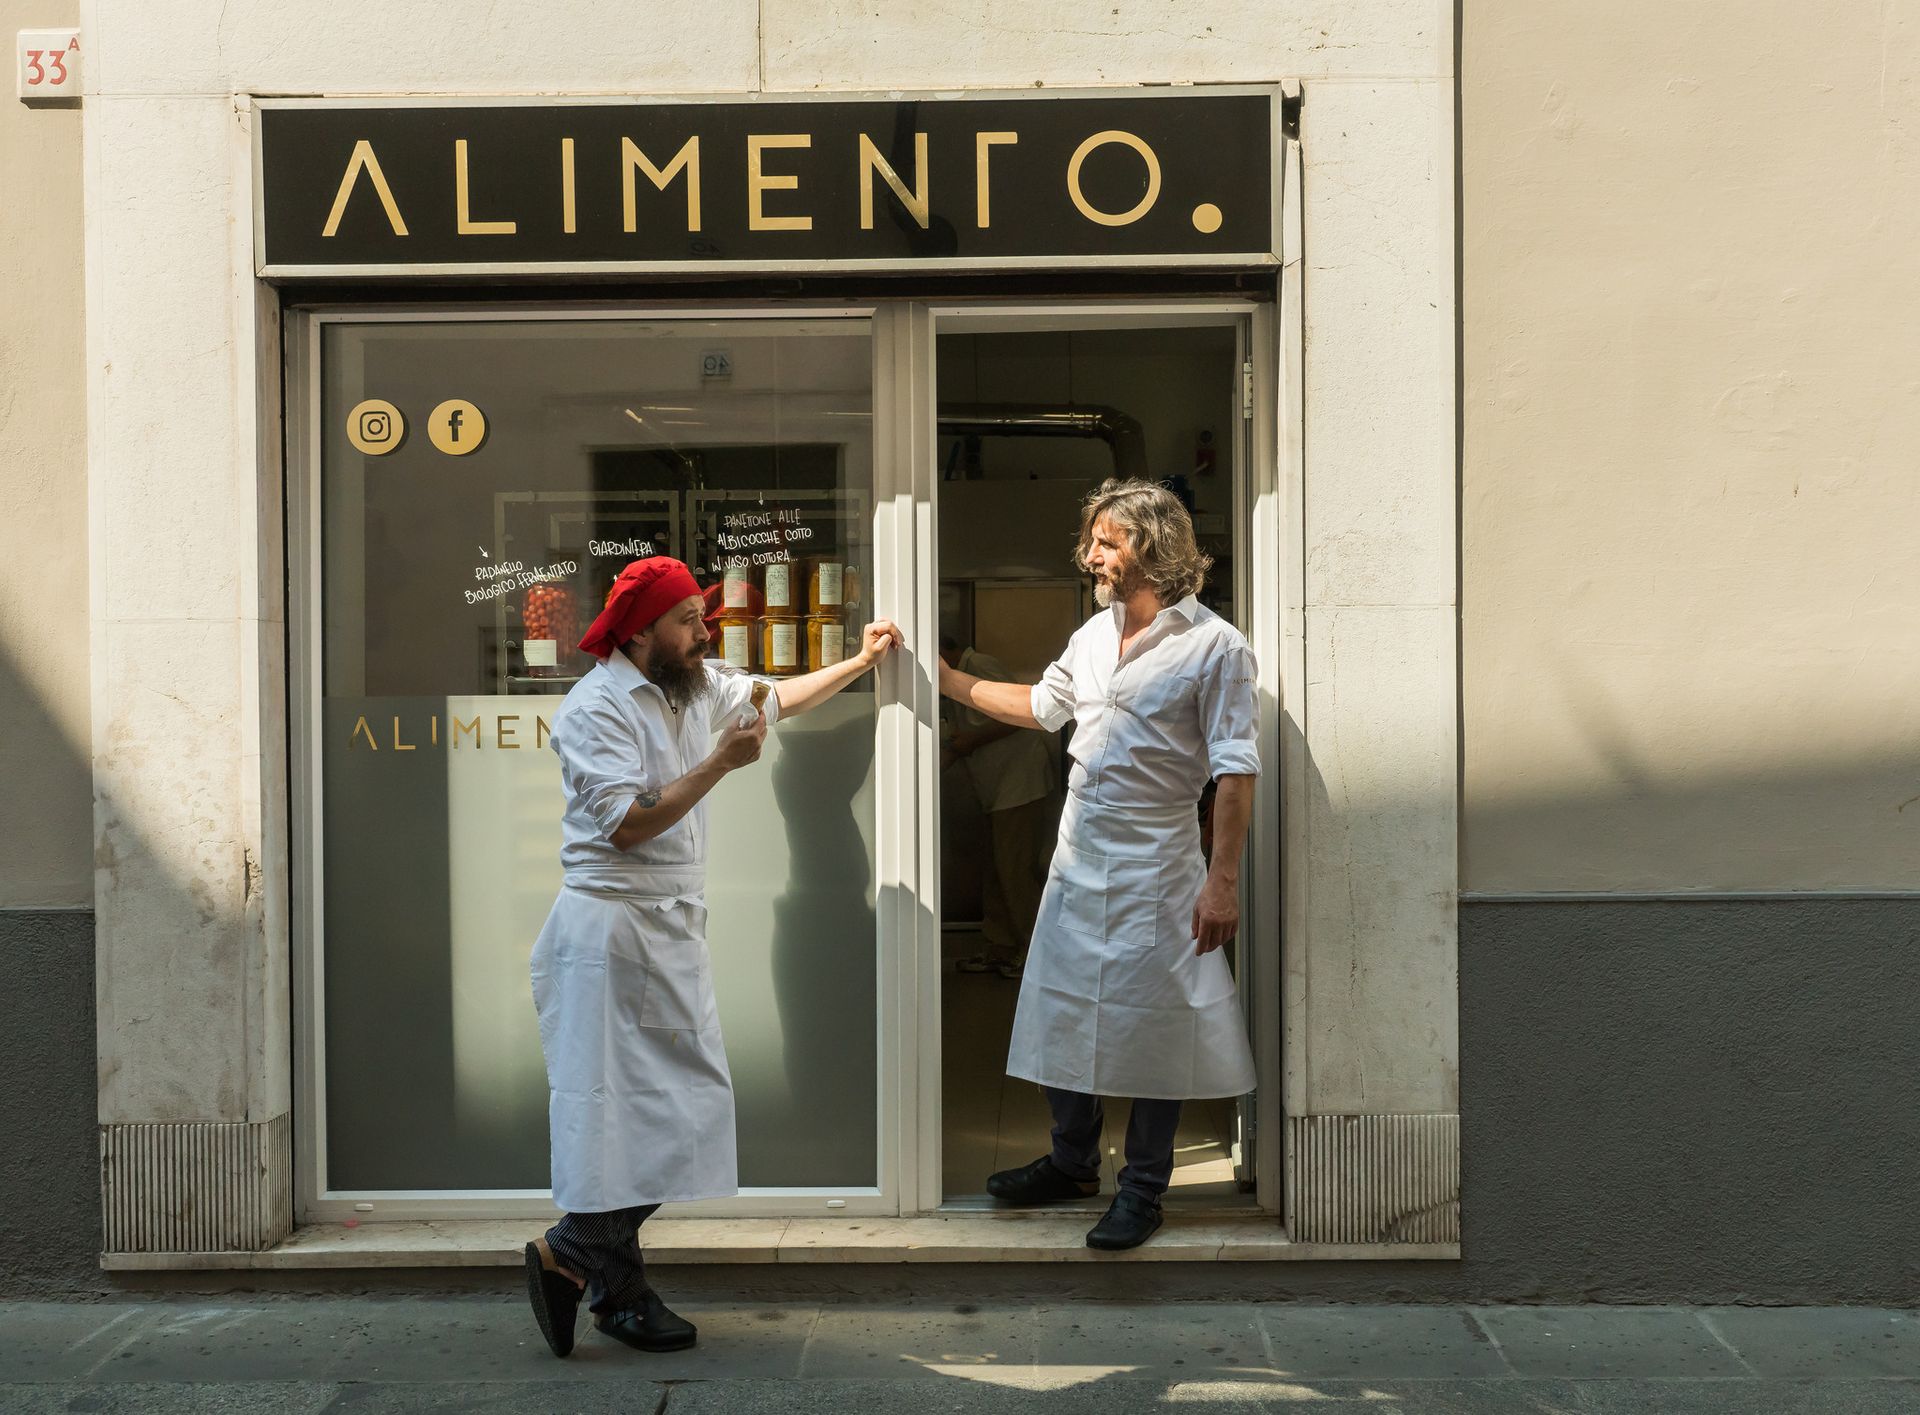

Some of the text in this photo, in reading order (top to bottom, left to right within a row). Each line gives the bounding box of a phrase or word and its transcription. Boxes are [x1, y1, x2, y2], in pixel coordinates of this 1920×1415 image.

[778, 508, 801, 525] ALLE
[717, 527, 813, 550] ALBICOCCHE COTTO
[711, 555, 722, 573] IN
[725, 555, 749, 570] VASO
[464, 560, 577, 605] BIOLOGICO FERMENTATO
[350, 714, 551, 750] ALIMEN
